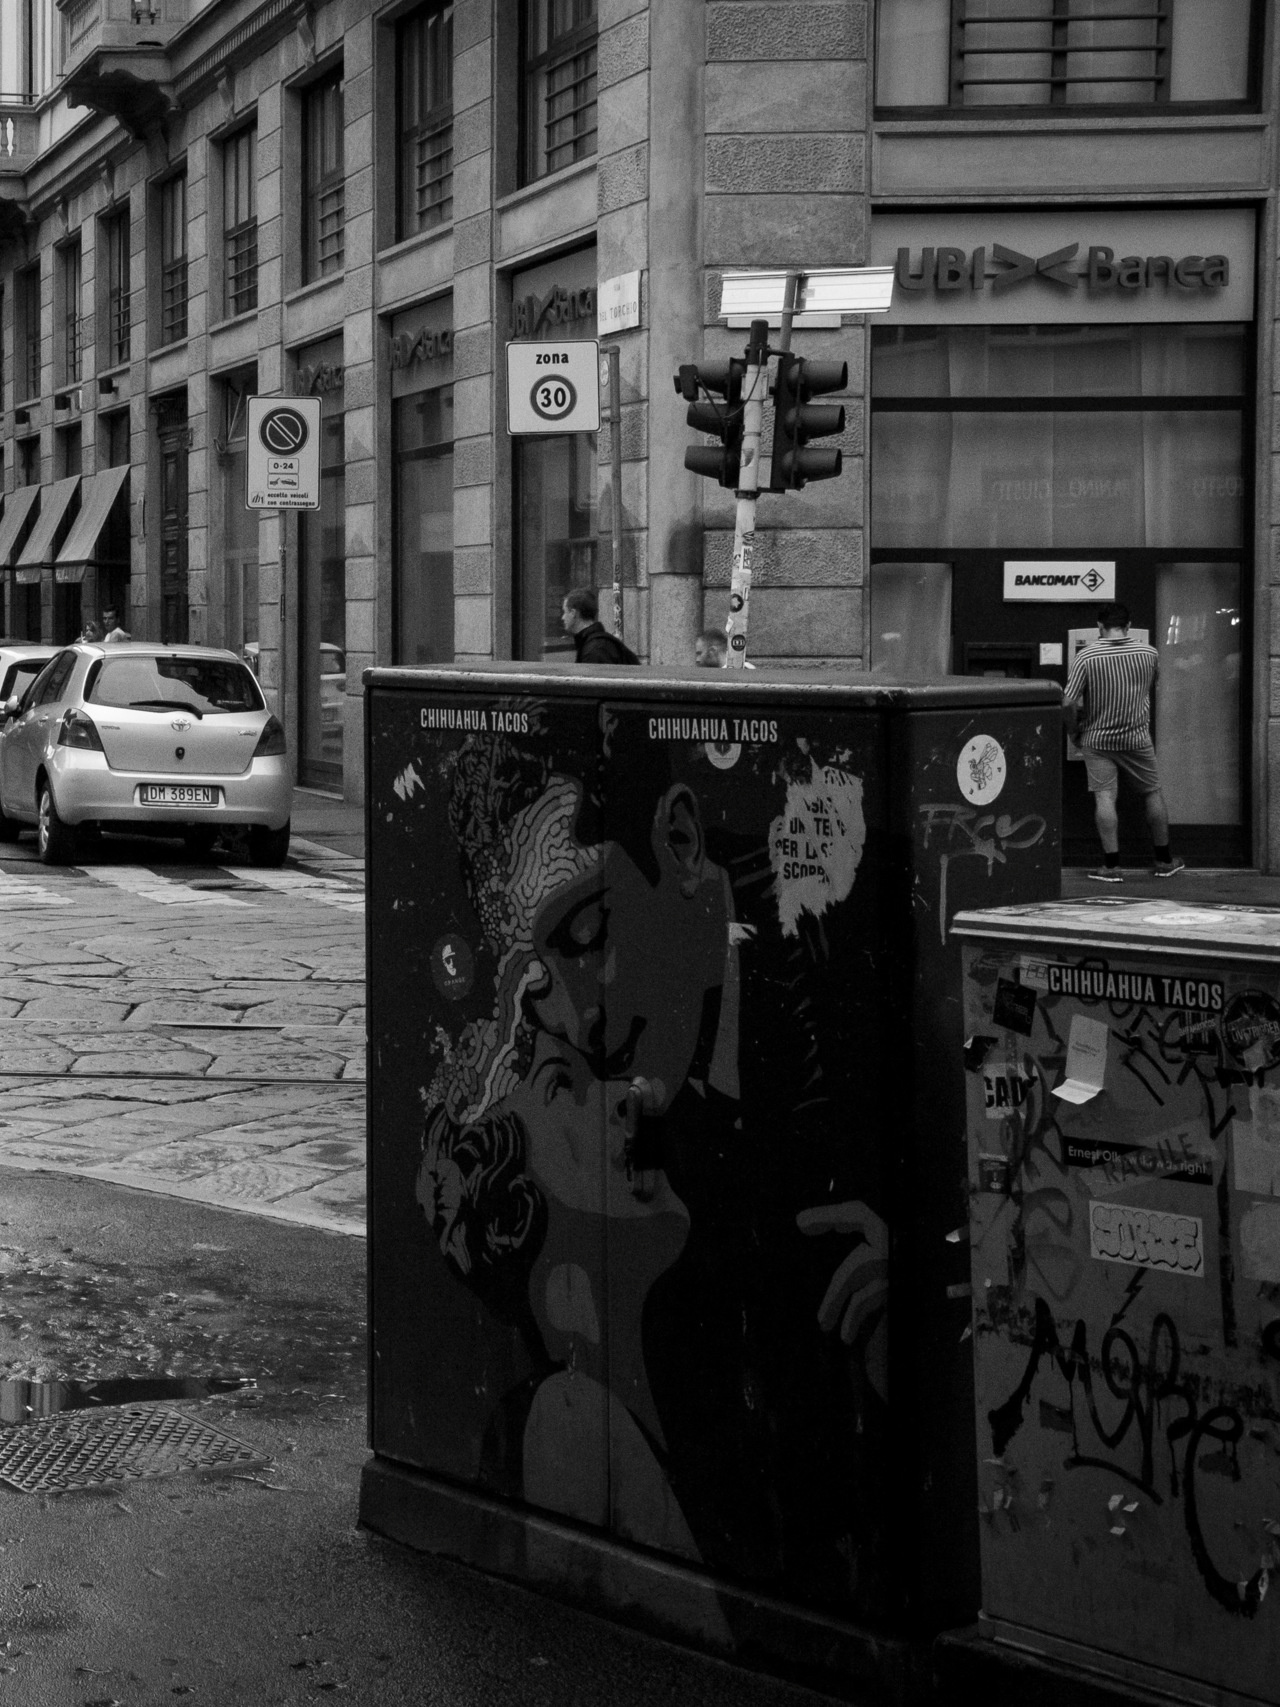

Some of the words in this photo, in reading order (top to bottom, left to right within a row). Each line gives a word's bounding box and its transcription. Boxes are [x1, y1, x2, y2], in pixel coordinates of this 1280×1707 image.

[896, 246, 985, 291] UBI
[1088, 245, 1229, 290] Banca
[609, 301, 638, 319] TORCHIO
[535, 353, 569, 365] zona
[540, 387, 567, 408] 30
[1015, 575, 1080, 586] BANCOMAT
[420, 707, 488, 731] CHIHUAHUA
[491, 711, 529, 734] TACOS
[648, 717, 729, 742] CHIHUAHUA
[733, 718, 778, 743] TACOS
[150, 786, 166, 800] DM
[170, 787, 210, 801] 389EN
[1049, 966, 1157, 1003] CHIHUAHUA
[1161, 977, 1223, 1011] TACOS
[1180, 1161, 1207, 1175] right
